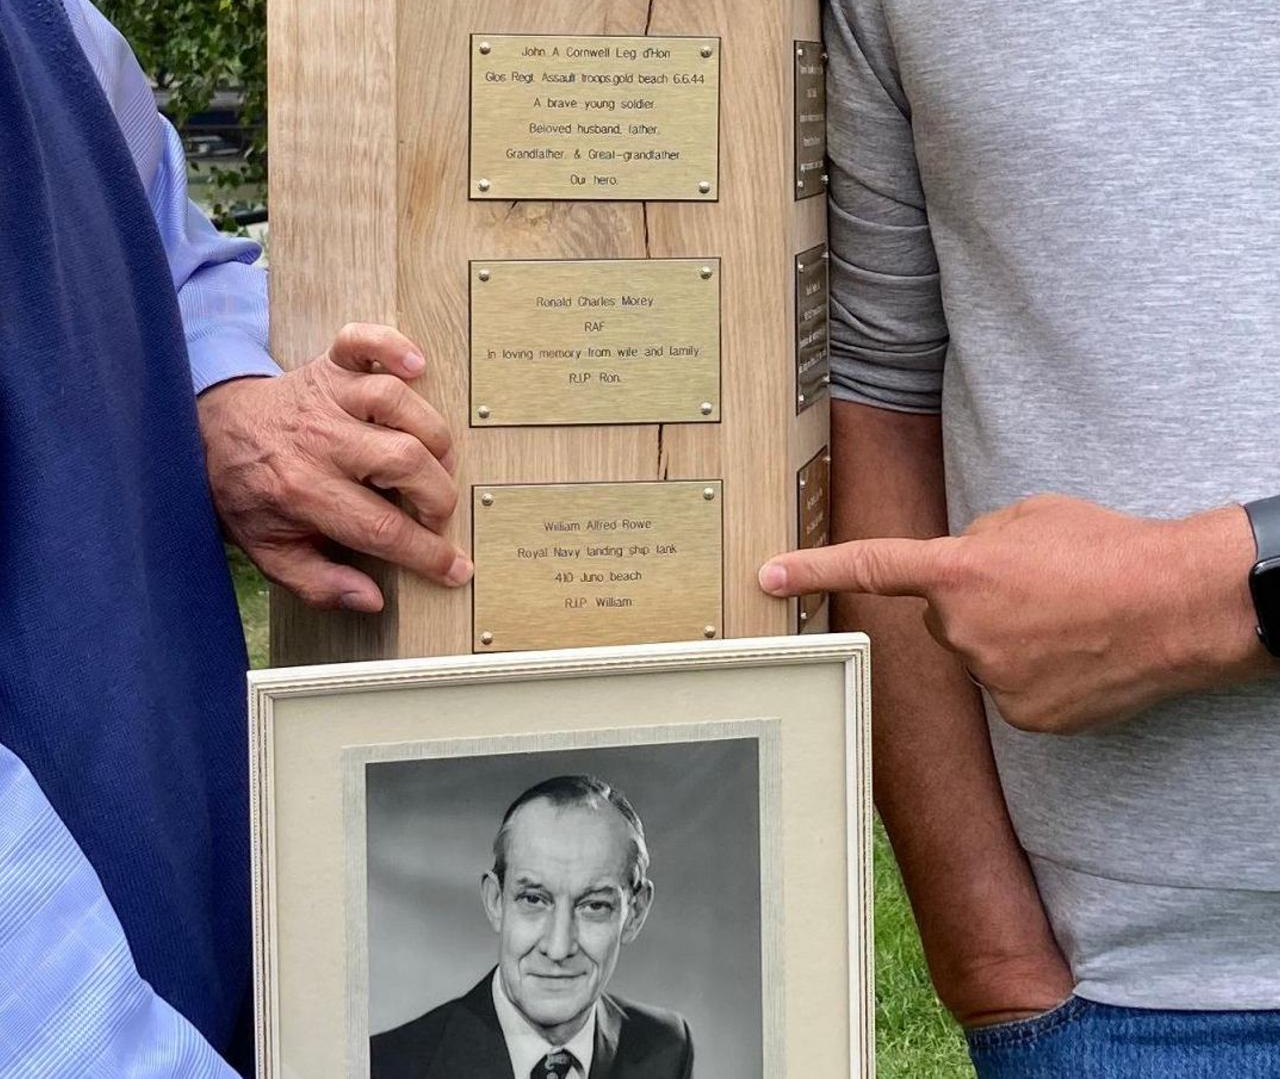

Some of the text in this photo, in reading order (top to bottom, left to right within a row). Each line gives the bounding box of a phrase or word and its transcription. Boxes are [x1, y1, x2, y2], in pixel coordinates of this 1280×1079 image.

[522, 47, 545, 57] John
[552, 47, 560, 57] A
[566, 47, 610, 58] Cornwell
[616, 48, 636, 60] Leg
[639, 73, 668, 84] beach
[533, 98, 541, 107] A
[547, 98, 577, 108] brave
[584, 100, 615, 110] young
[574, 149, 581, 159] &
[570, 175, 586, 185] Our
[536, 297, 571, 307] Ronald
[577, 297, 615, 306] Charles
[584, 322, 605, 332] RAF
[487, 349, 496, 358] In
[503, 349, 533, 360] loving
[540, 350, 581, 360] memory
[588, 348, 611, 357] from
[618, 347, 638, 357] wife
[645, 347, 663, 356] and
[544, 519, 652, 532] William Alfred Rowe
[517, 544, 677, 559] Royal Navy landing ship tank
[580, 572, 603, 582] Juno
[610, 571, 642, 581] beach
[596, 597, 633, 608] William
